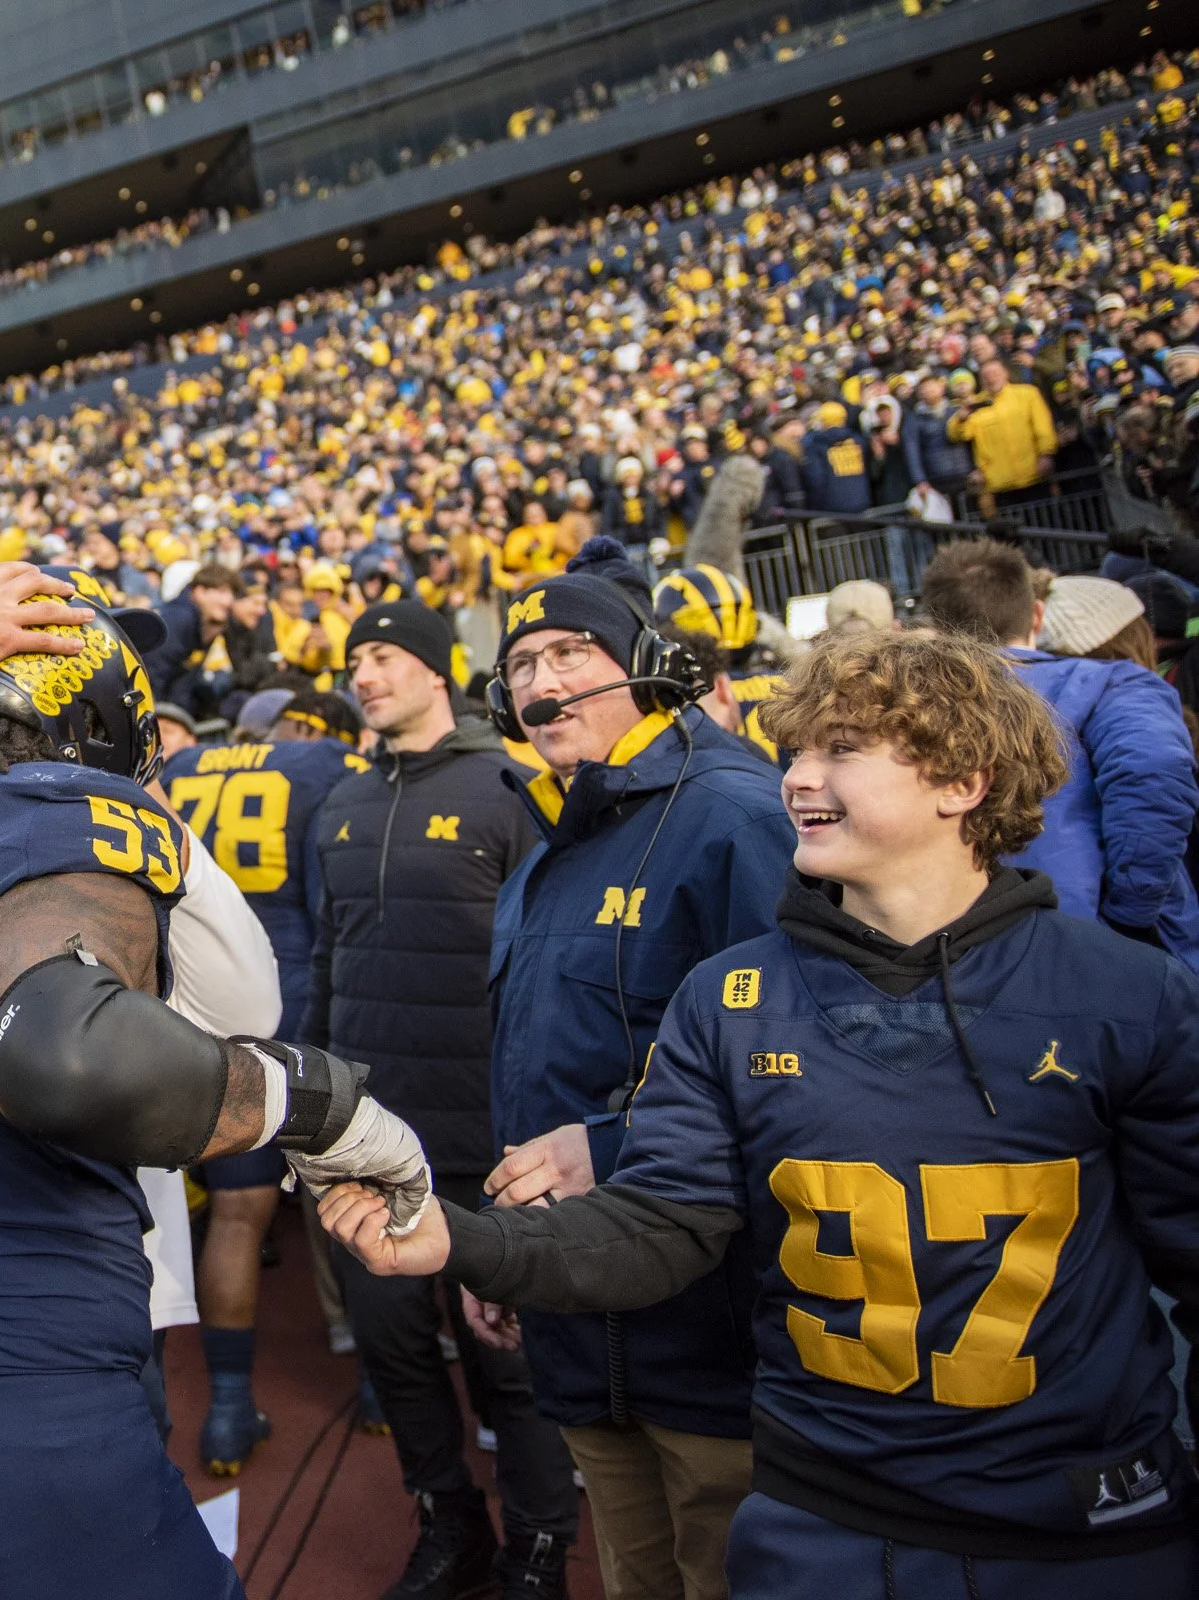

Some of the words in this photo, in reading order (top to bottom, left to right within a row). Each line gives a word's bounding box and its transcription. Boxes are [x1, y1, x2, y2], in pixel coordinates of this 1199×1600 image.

[507, 590, 546, 635] M
[85, 795, 181, 894] 53
[170, 770, 292, 893] 78
[425, 815, 461, 842] M
[595, 886, 647, 927] M
[732, 982, 751, 993] 42
[734, 972, 753, 982] TM
[769, 1157, 1080, 1409] 97
